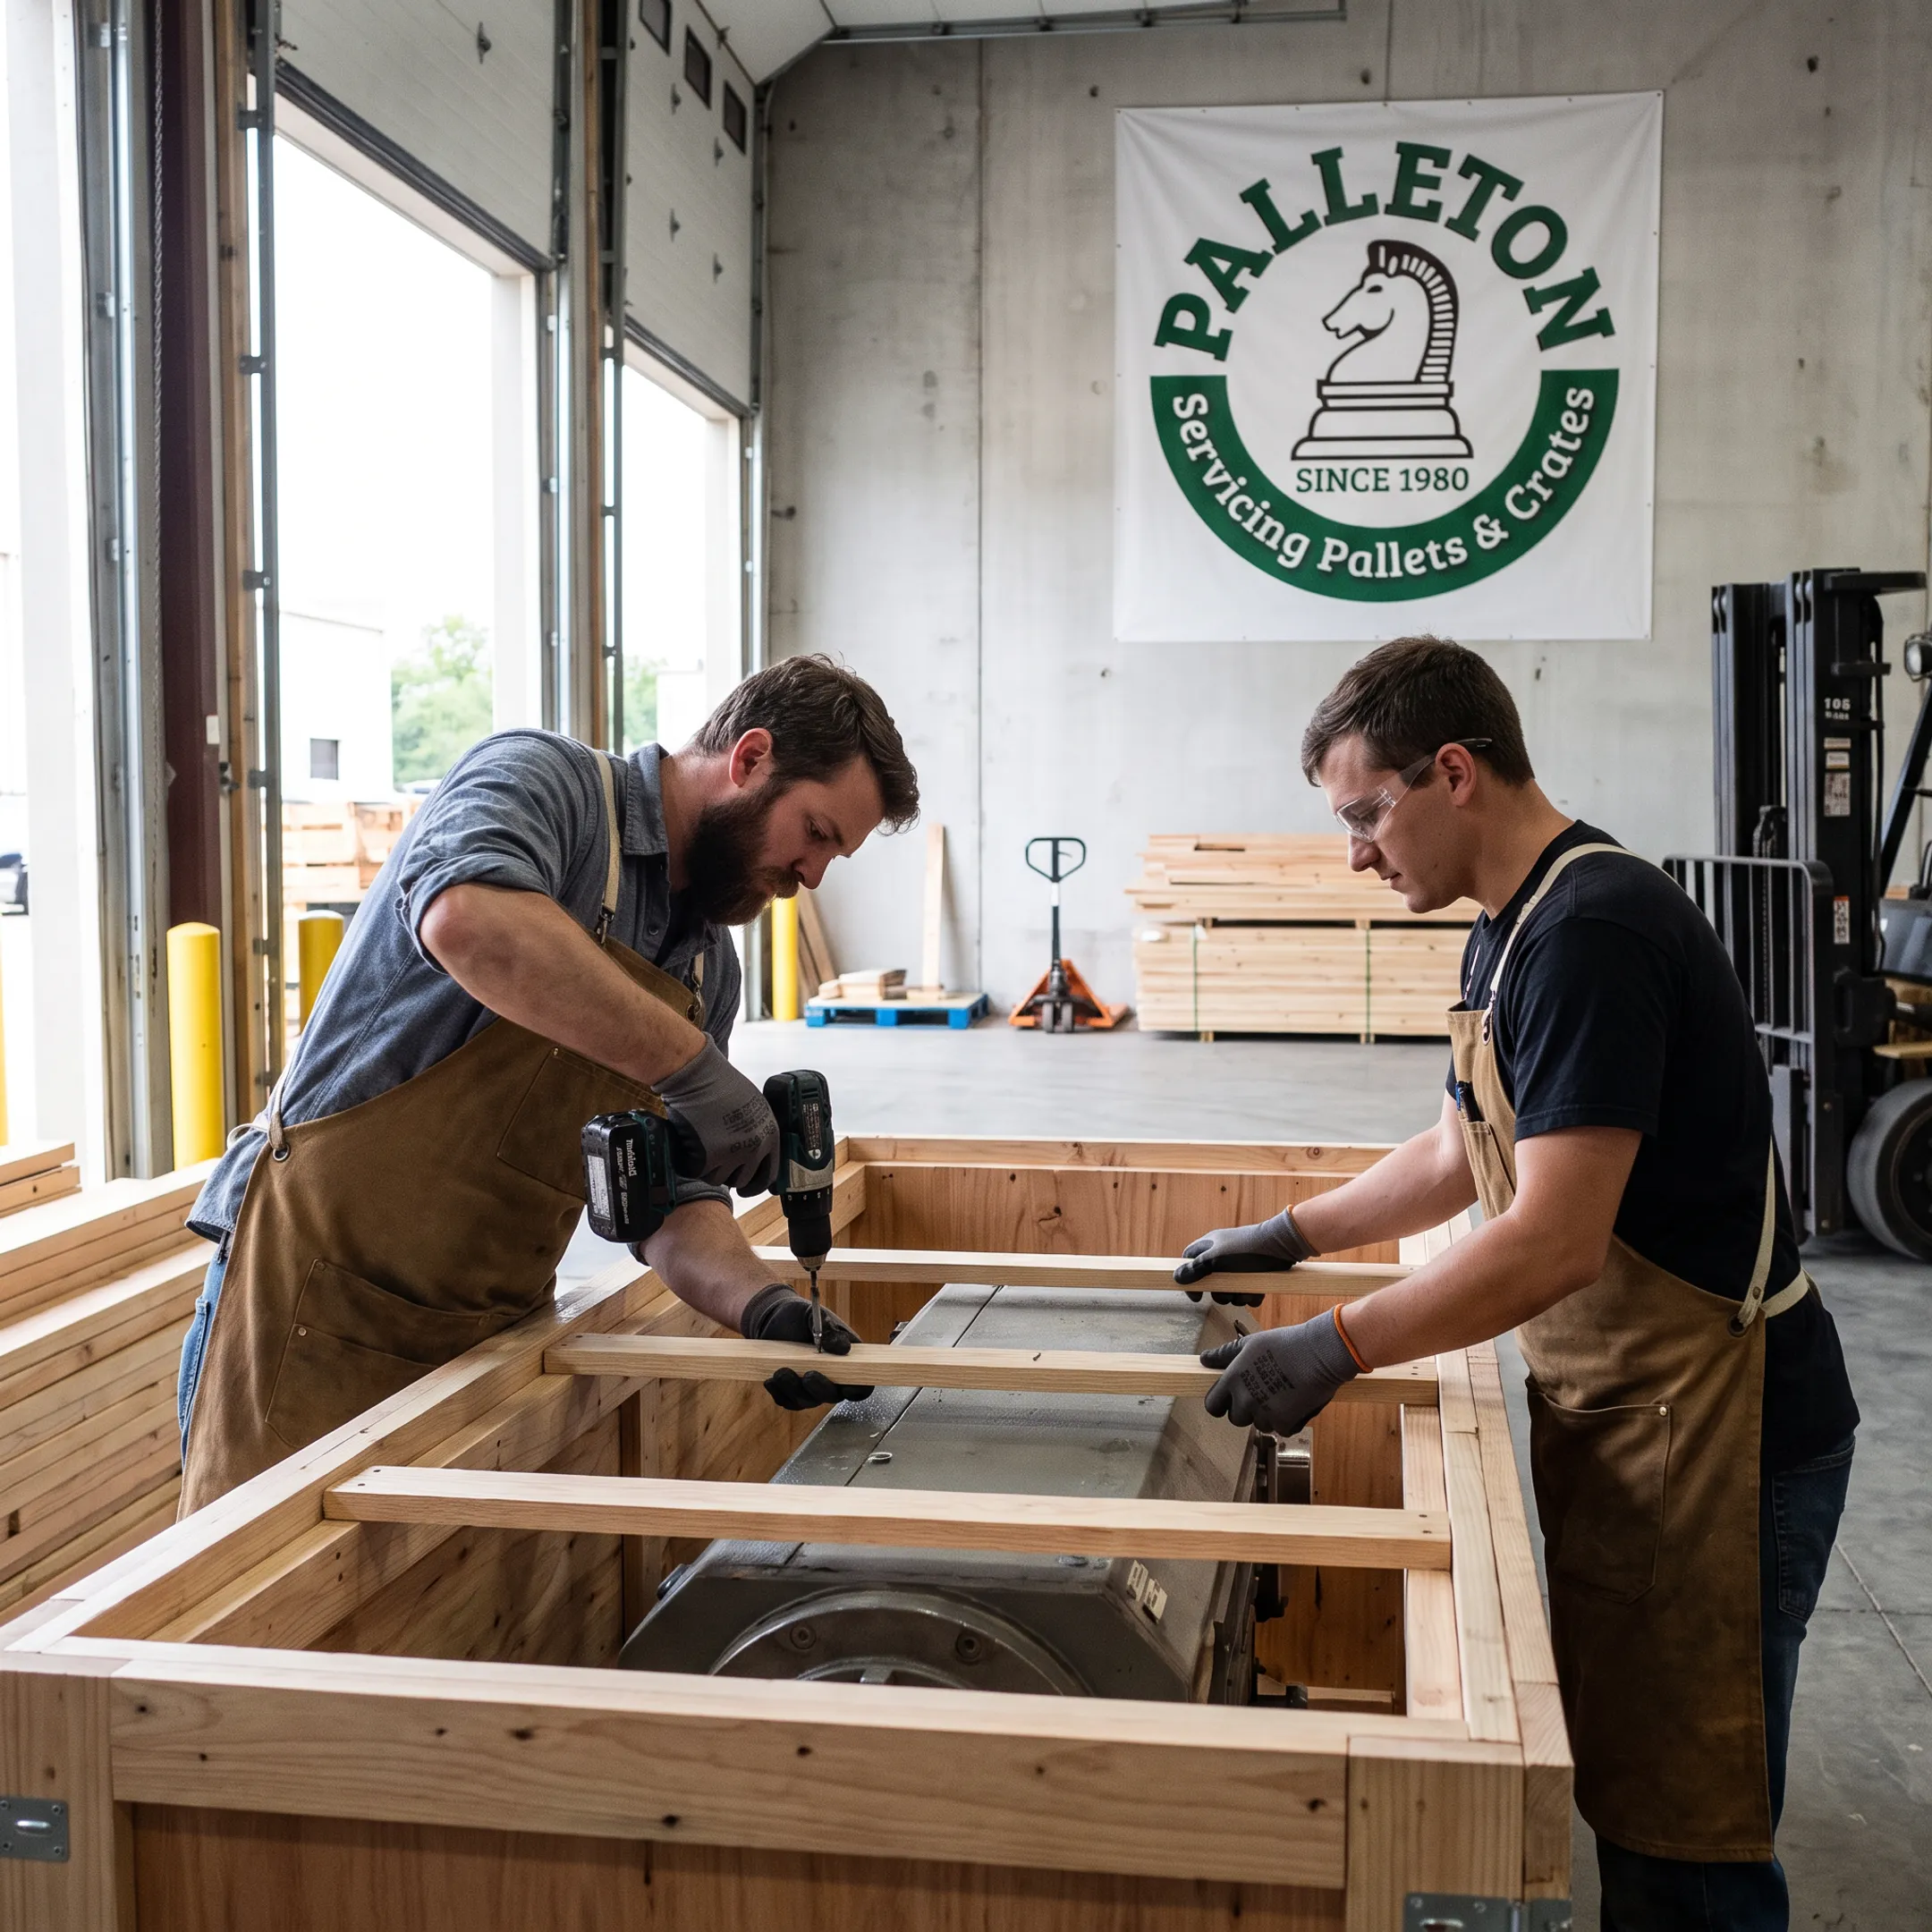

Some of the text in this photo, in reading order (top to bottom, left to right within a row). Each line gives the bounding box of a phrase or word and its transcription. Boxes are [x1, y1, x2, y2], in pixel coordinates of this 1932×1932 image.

[1154, 141, 1615, 361] PALLETON
[1174, 387, 1594, 579] Servicing Pallets & Crates
[1296, 467, 1470, 493] SINCE 1980
